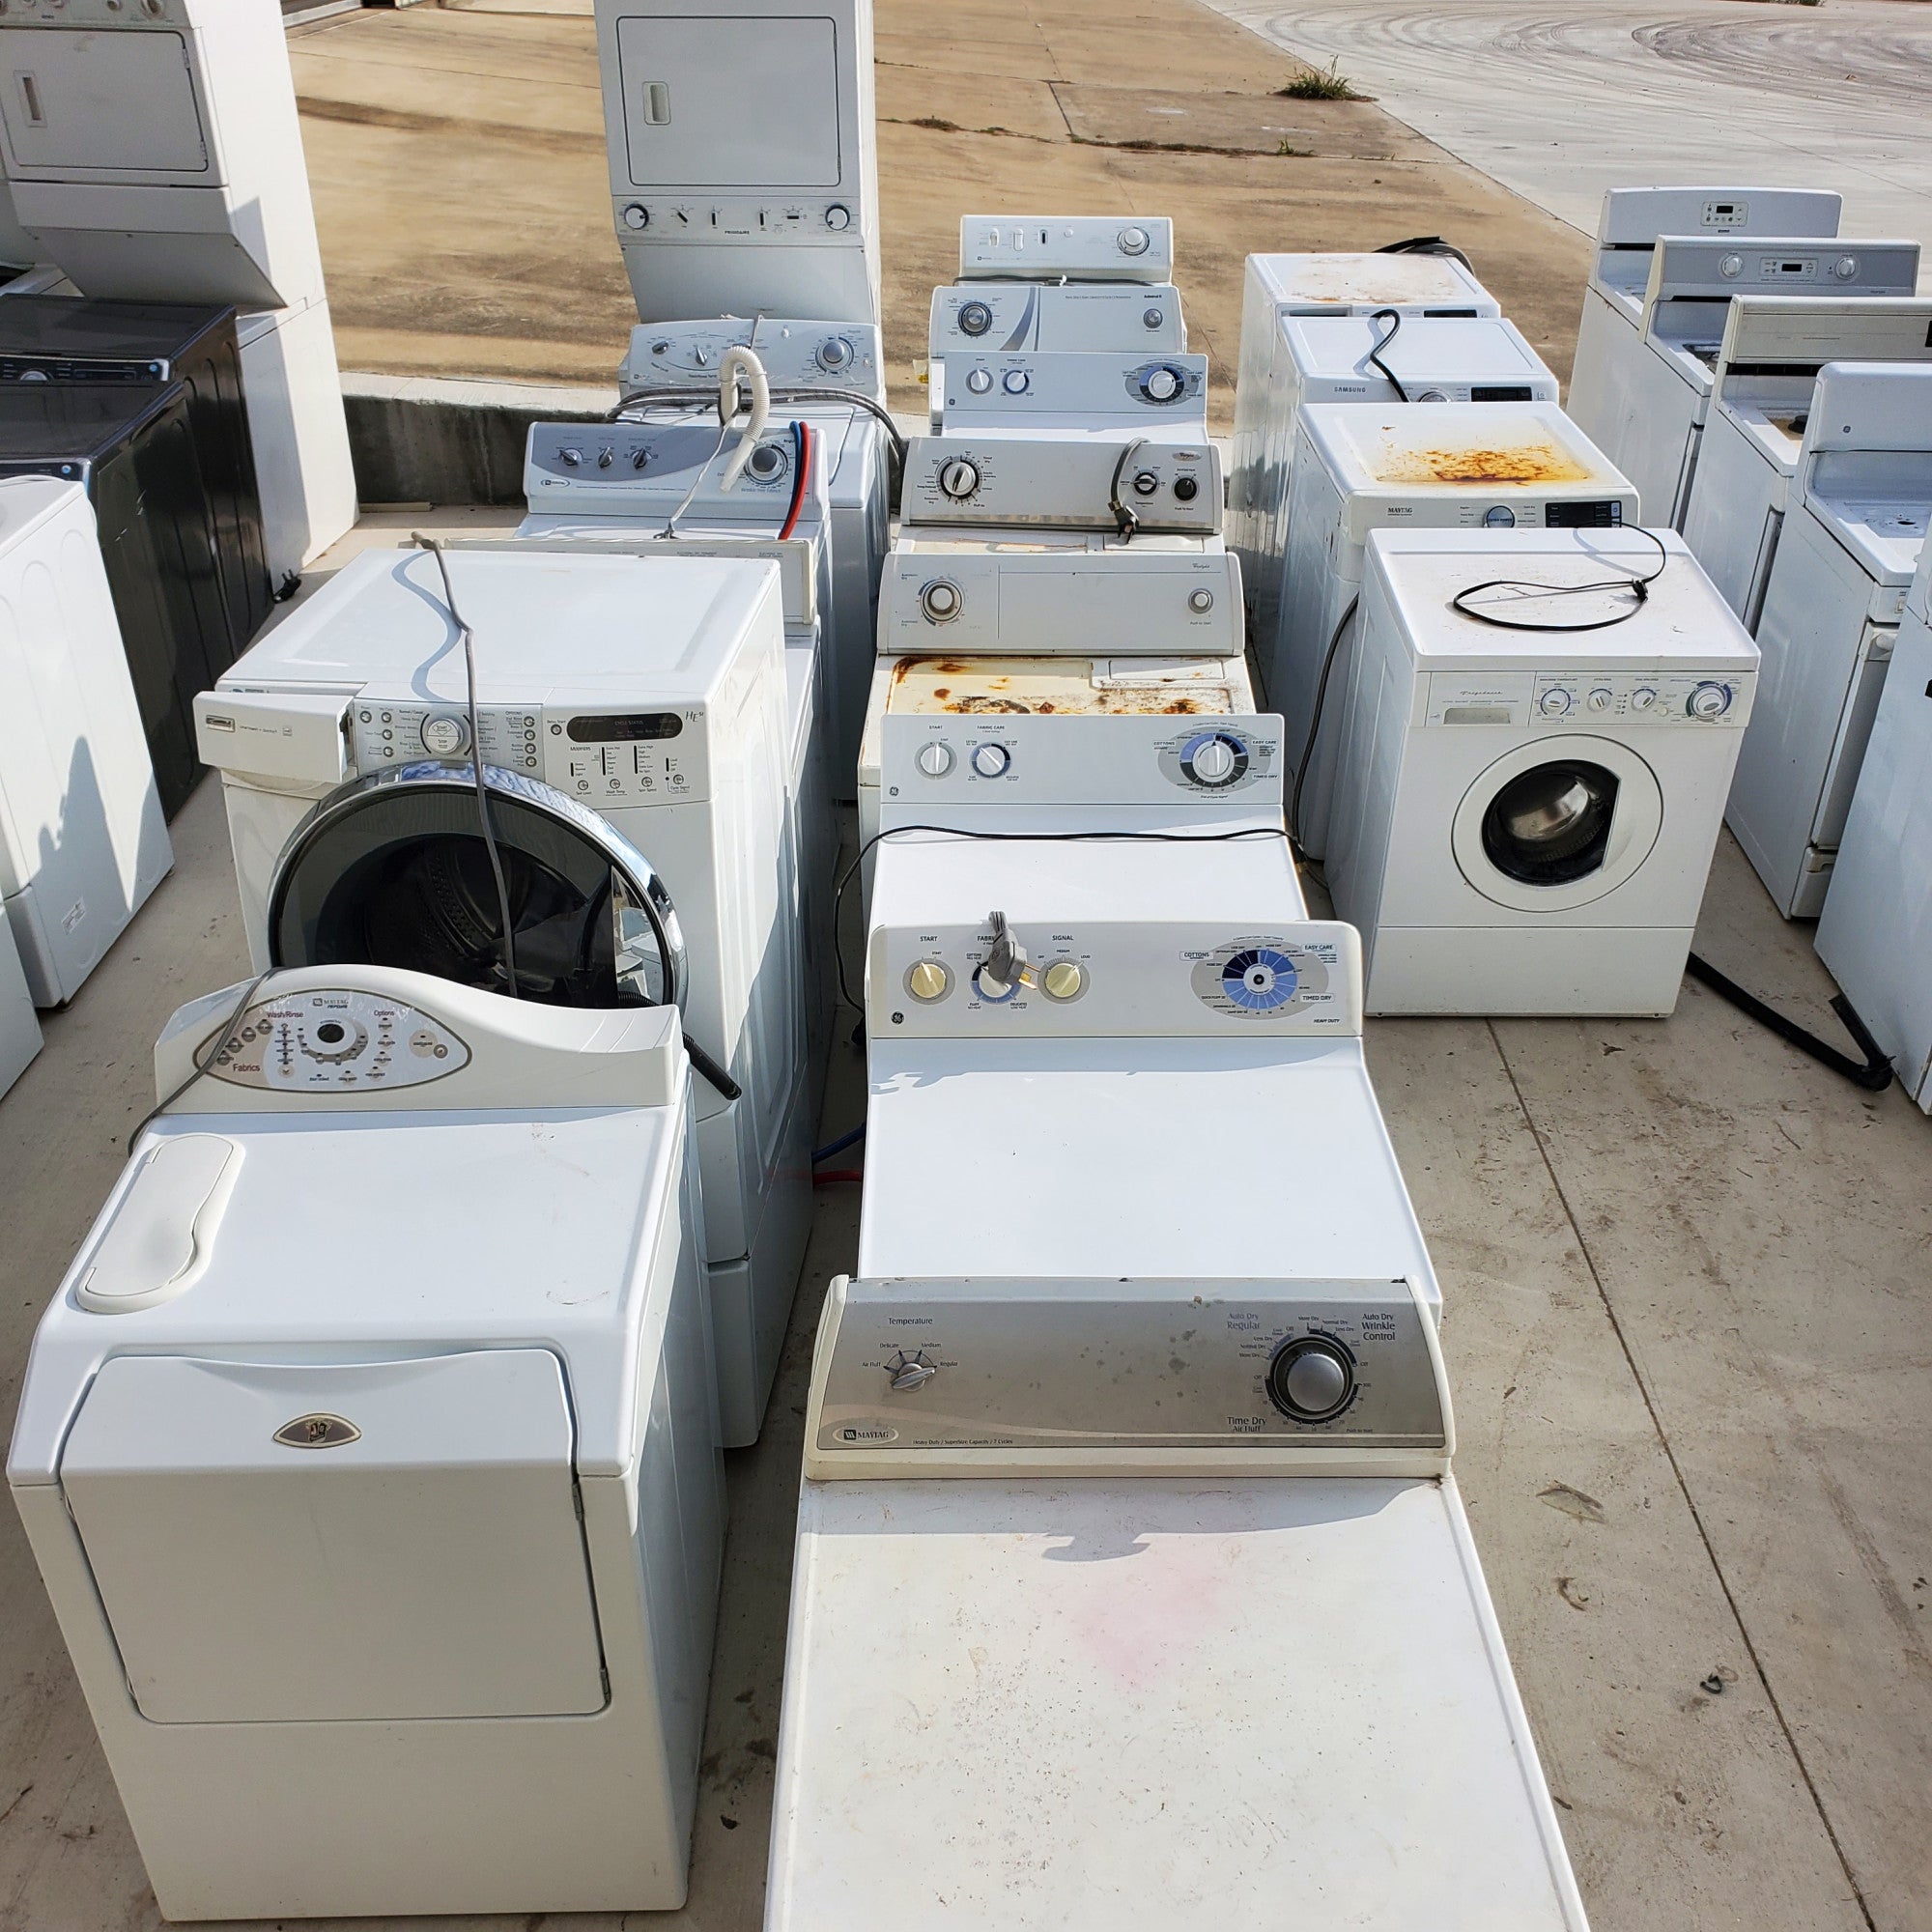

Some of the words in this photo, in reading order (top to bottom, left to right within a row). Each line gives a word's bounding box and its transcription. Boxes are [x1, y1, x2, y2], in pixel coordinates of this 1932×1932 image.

[1227, 1321, 1261, 1330] Regular
[1362, 1321, 1396, 1330] Wrinkle
[1363, 1331, 1396, 1341] Control
[1227, 1416, 1249, 1425] Time
[1252, 1416, 1267, 1426] Dry
